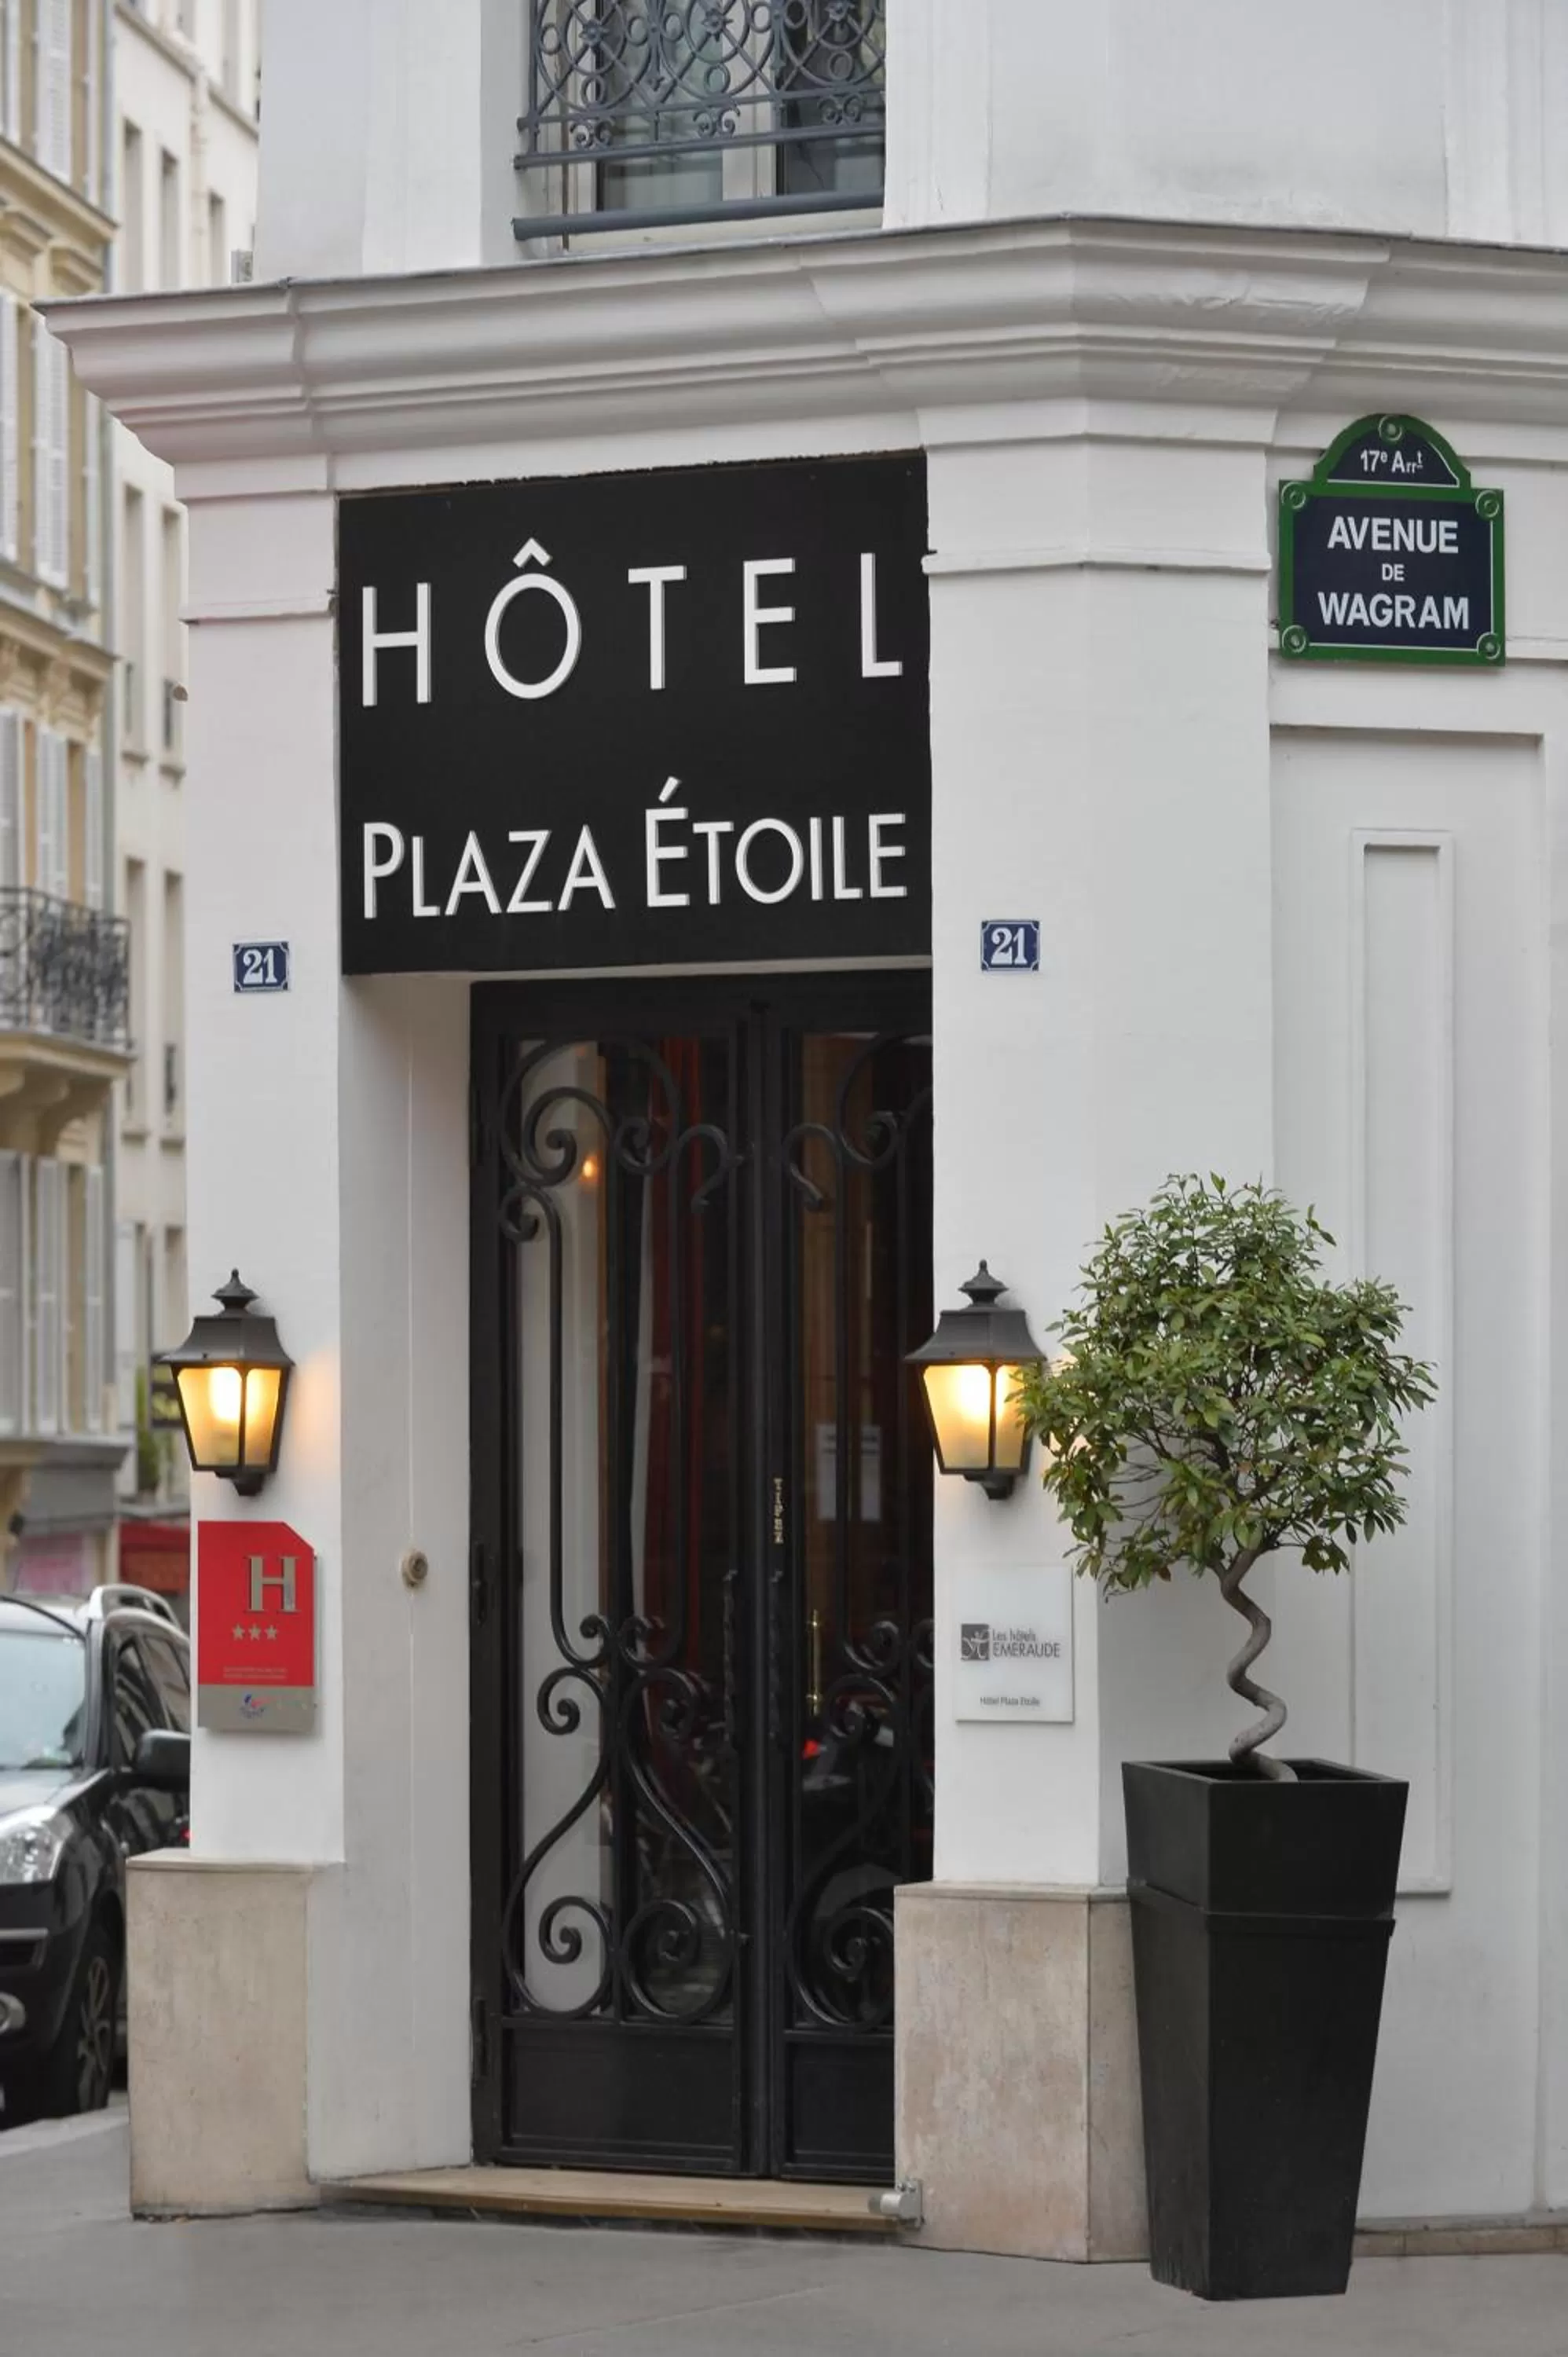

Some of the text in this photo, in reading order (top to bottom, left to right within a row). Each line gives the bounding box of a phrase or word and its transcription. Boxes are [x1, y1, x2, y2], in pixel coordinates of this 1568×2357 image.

[1327, 515, 1459, 554] AVENUE
[1382, 563, 1405, 581] DE
[362, 537, 903, 707] HÔTEL
[1317, 592, 1469, 630] WAGRAM
[364, 775, 907, 918] PLAZA ÉTOILE
[991, 927, 1028, 965] 21
[243, 948, 277, 984] 21
[247, 1556, 299, 1613] H
